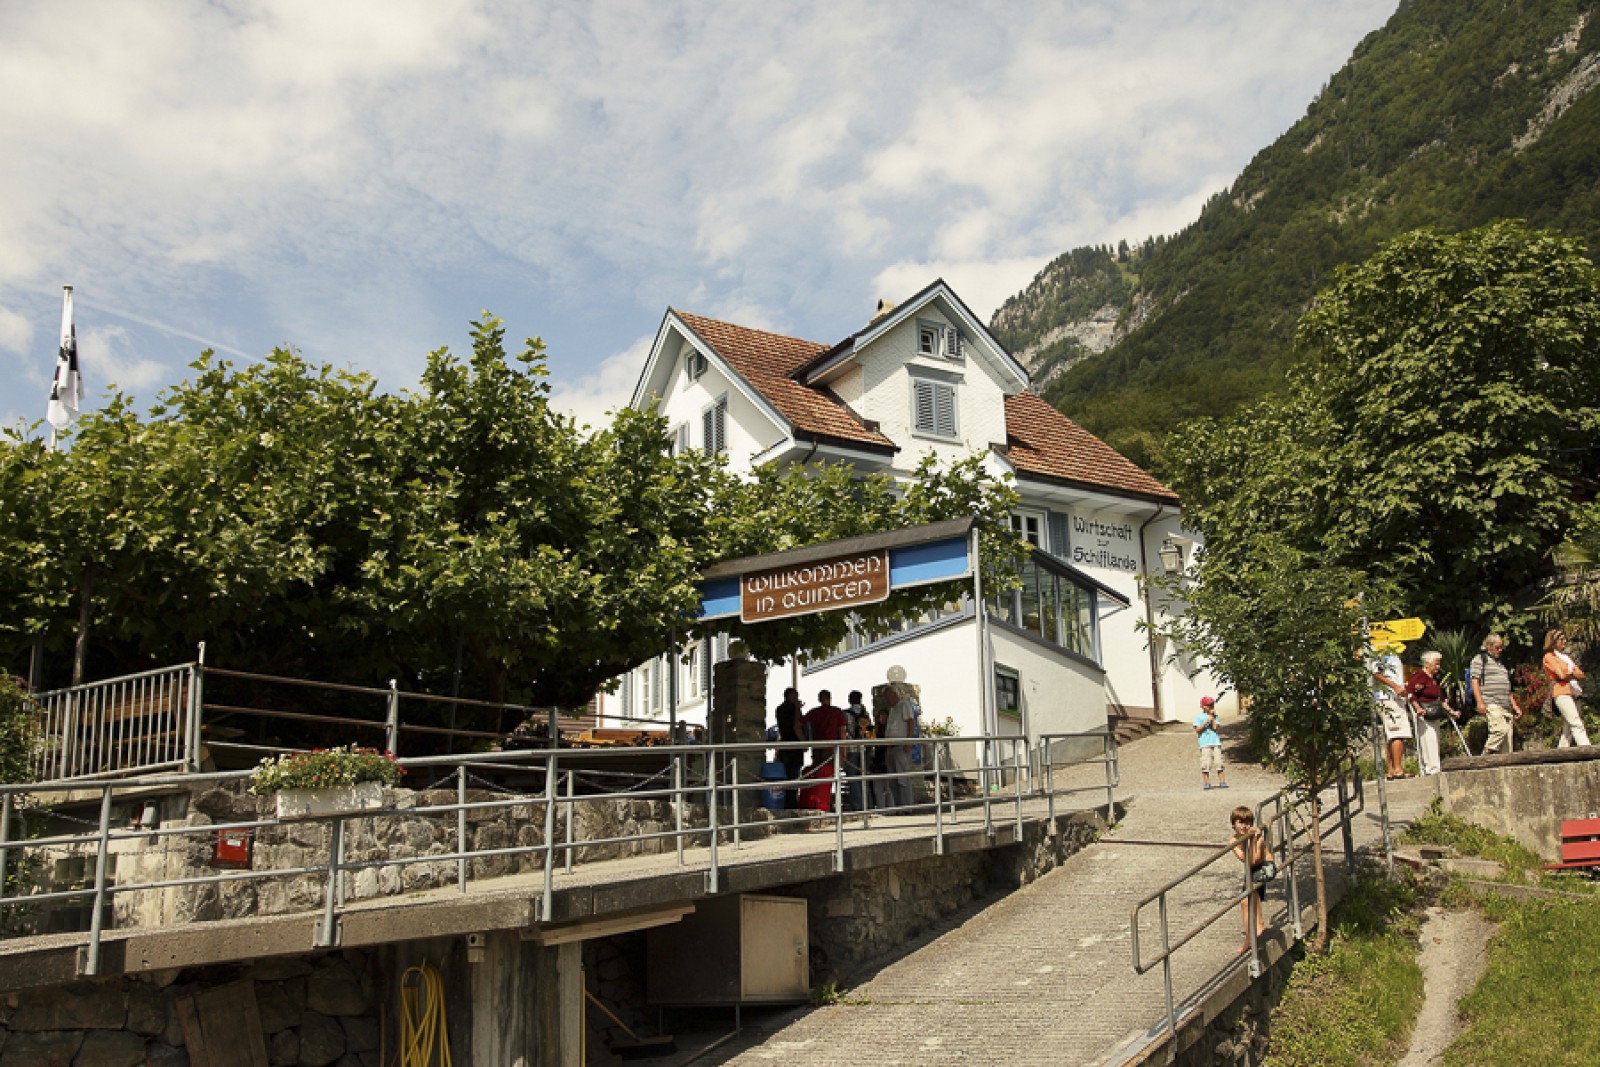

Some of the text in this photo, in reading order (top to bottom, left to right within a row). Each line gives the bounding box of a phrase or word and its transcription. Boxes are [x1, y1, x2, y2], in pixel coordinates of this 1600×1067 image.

[1073, 515, 1132, 541] Wirtschaft
[747, 555, 881, 593] WILLKOMMEN
[756, 579, 872, 613] IN QUINTEN
